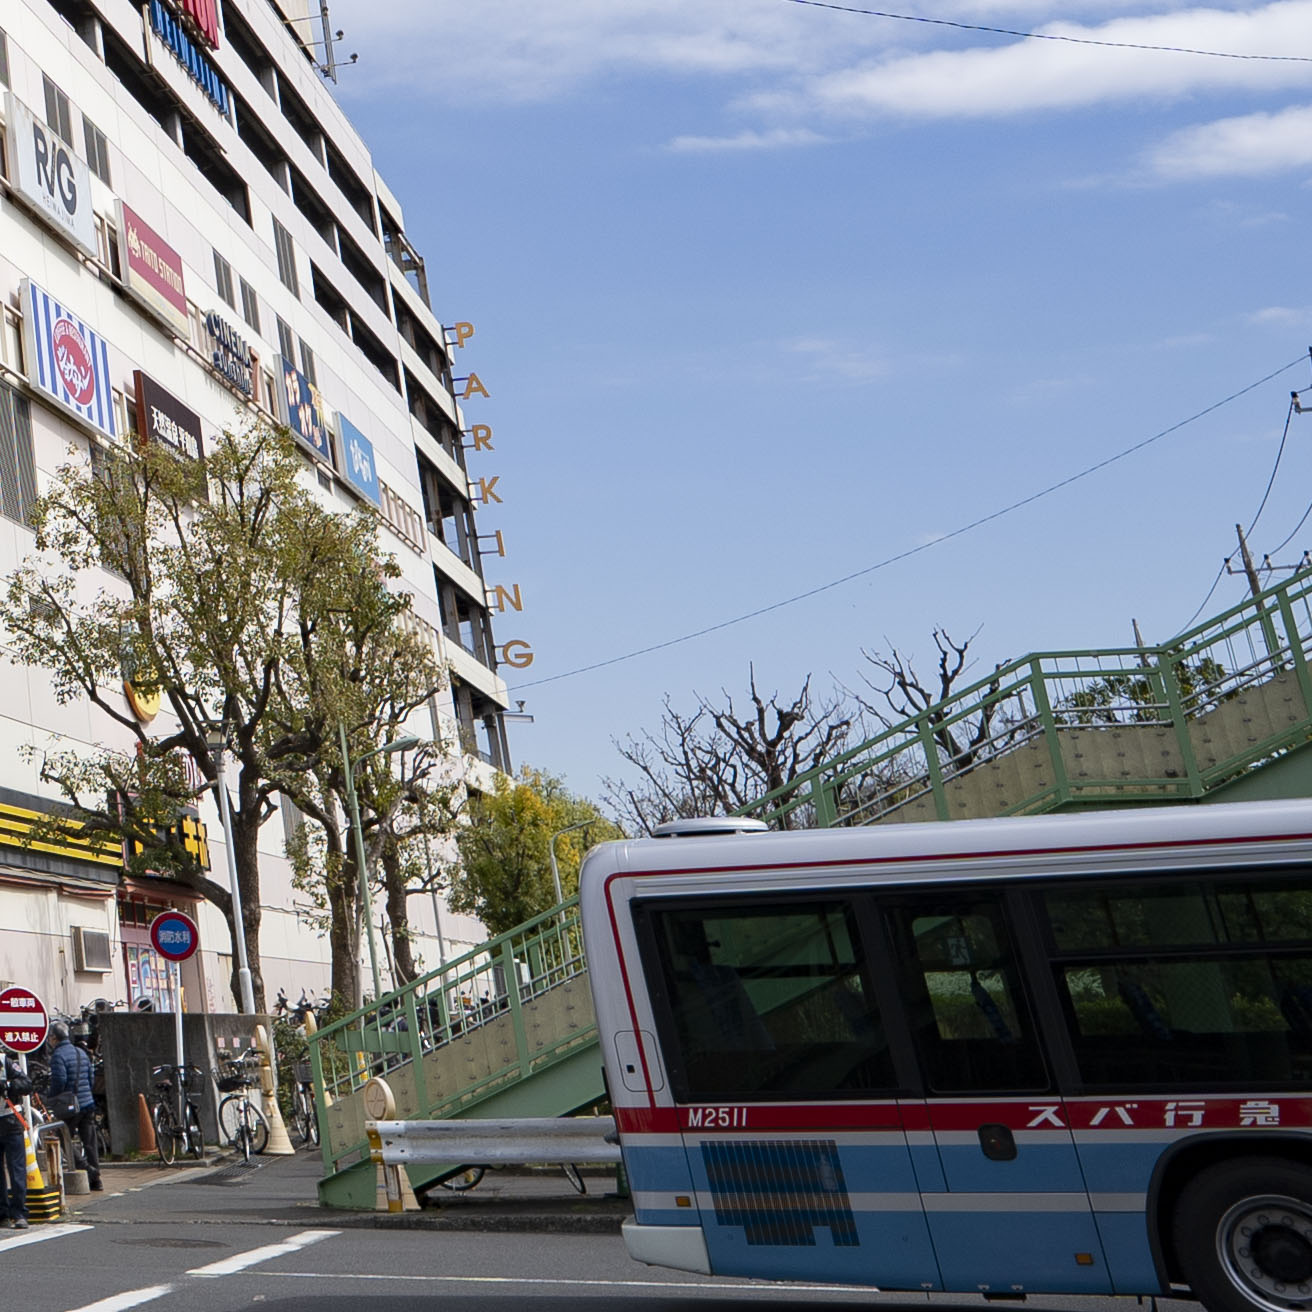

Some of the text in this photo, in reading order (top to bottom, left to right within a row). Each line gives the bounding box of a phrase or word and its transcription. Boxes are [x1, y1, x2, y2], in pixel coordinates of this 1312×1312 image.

[140, 240, 183, 296] TAITO STATION
[206, 310, 253, 368] CINEMA
[455, 321, 533, 668] PARKING
[688, 1107, 748, 1128] M2511
